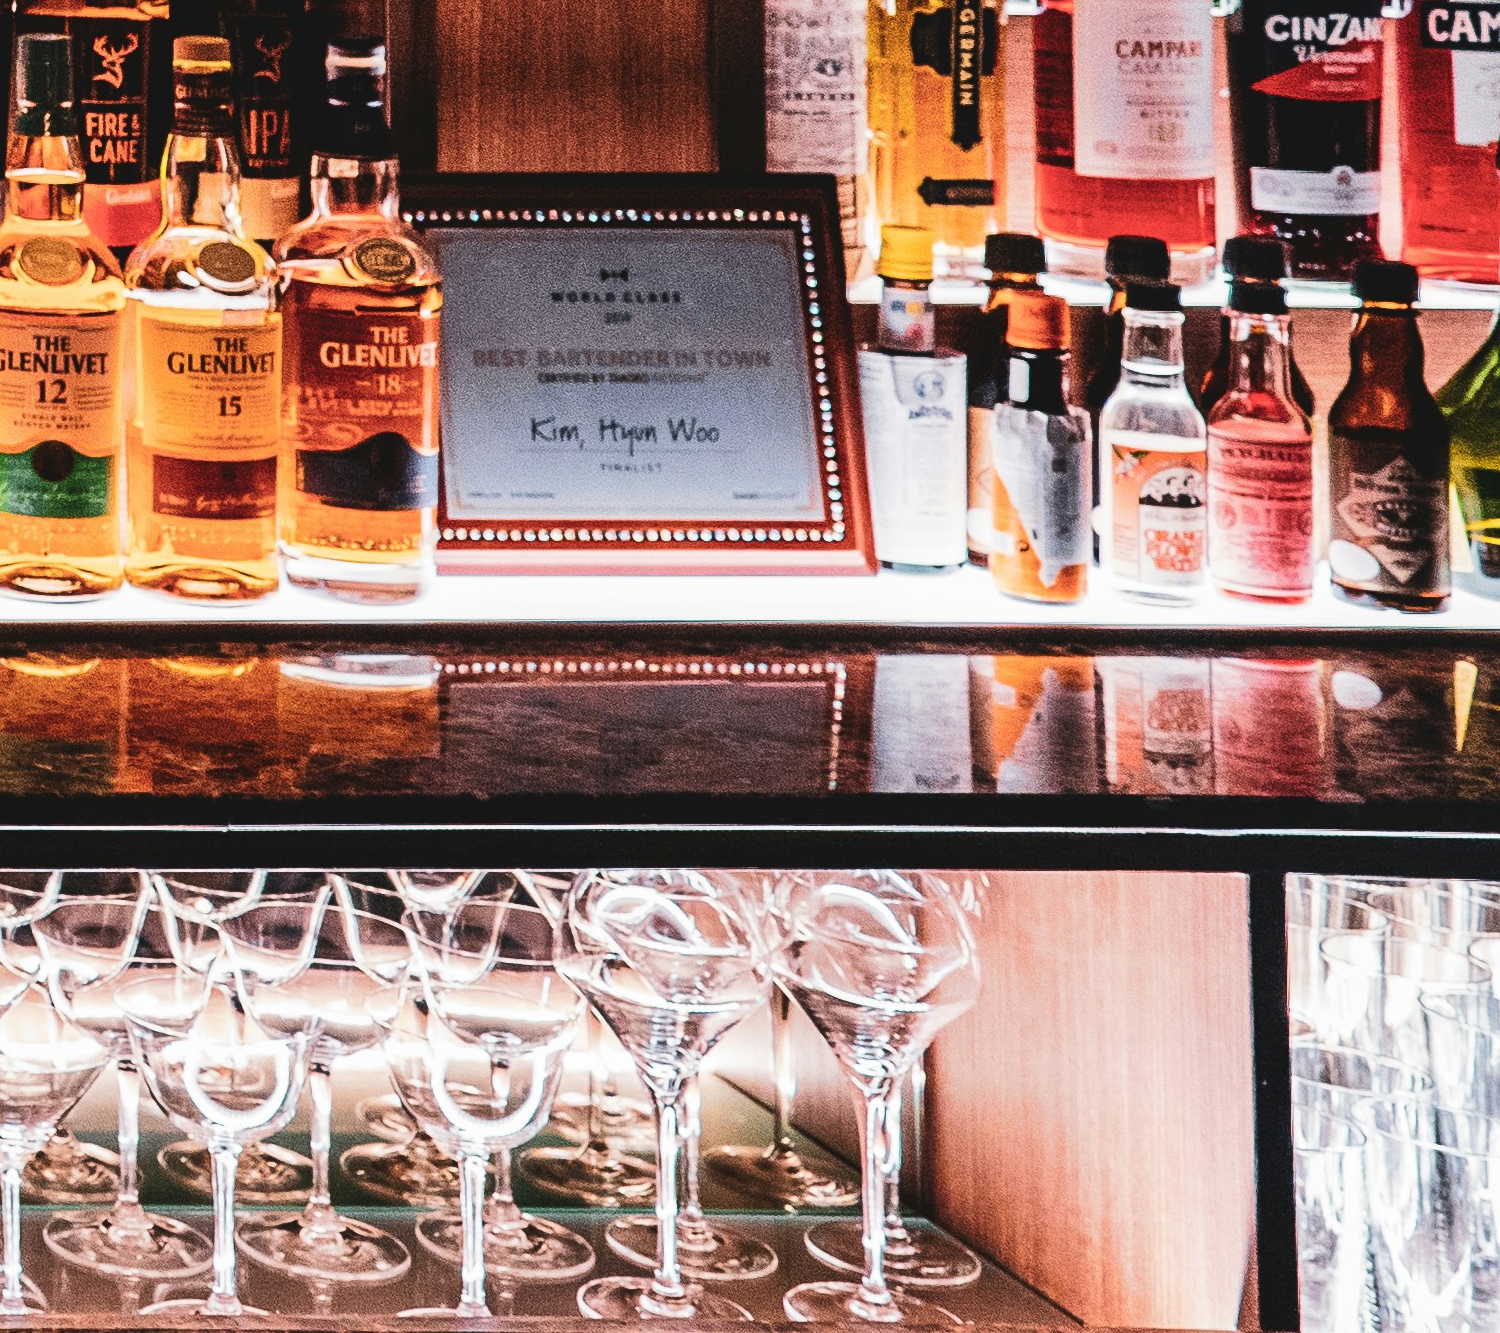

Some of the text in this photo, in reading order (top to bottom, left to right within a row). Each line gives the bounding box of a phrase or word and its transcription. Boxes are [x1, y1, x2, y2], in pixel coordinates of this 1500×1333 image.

[1264, 13, 1384, 46] CINZAN
[1115, 39, 1202, 60] CAMPAR
[85, 111, 127, 137] FIRE
[90, 138, 139, 164] CANE
[32, 334, 71, 353] THE
[213, 336, 248, 353] THE
[369, 326, 409, 343] THE
[167, 351, 275, 375] GLENLIVET
[319, 340, 439, 369] GLENLIVET
[473, 349, 527, 368] BEST
[537, 349, 668, 368] BARTENDER
[702, 349, 772, 368] TOWN
[35, 379, 69, 404] 12
[374, 374, 401, 395] 18
[218, 396, 243, 417] 15
[529, 416, 586, 450] Kim,
[667, 416, 721, 444] Woo
